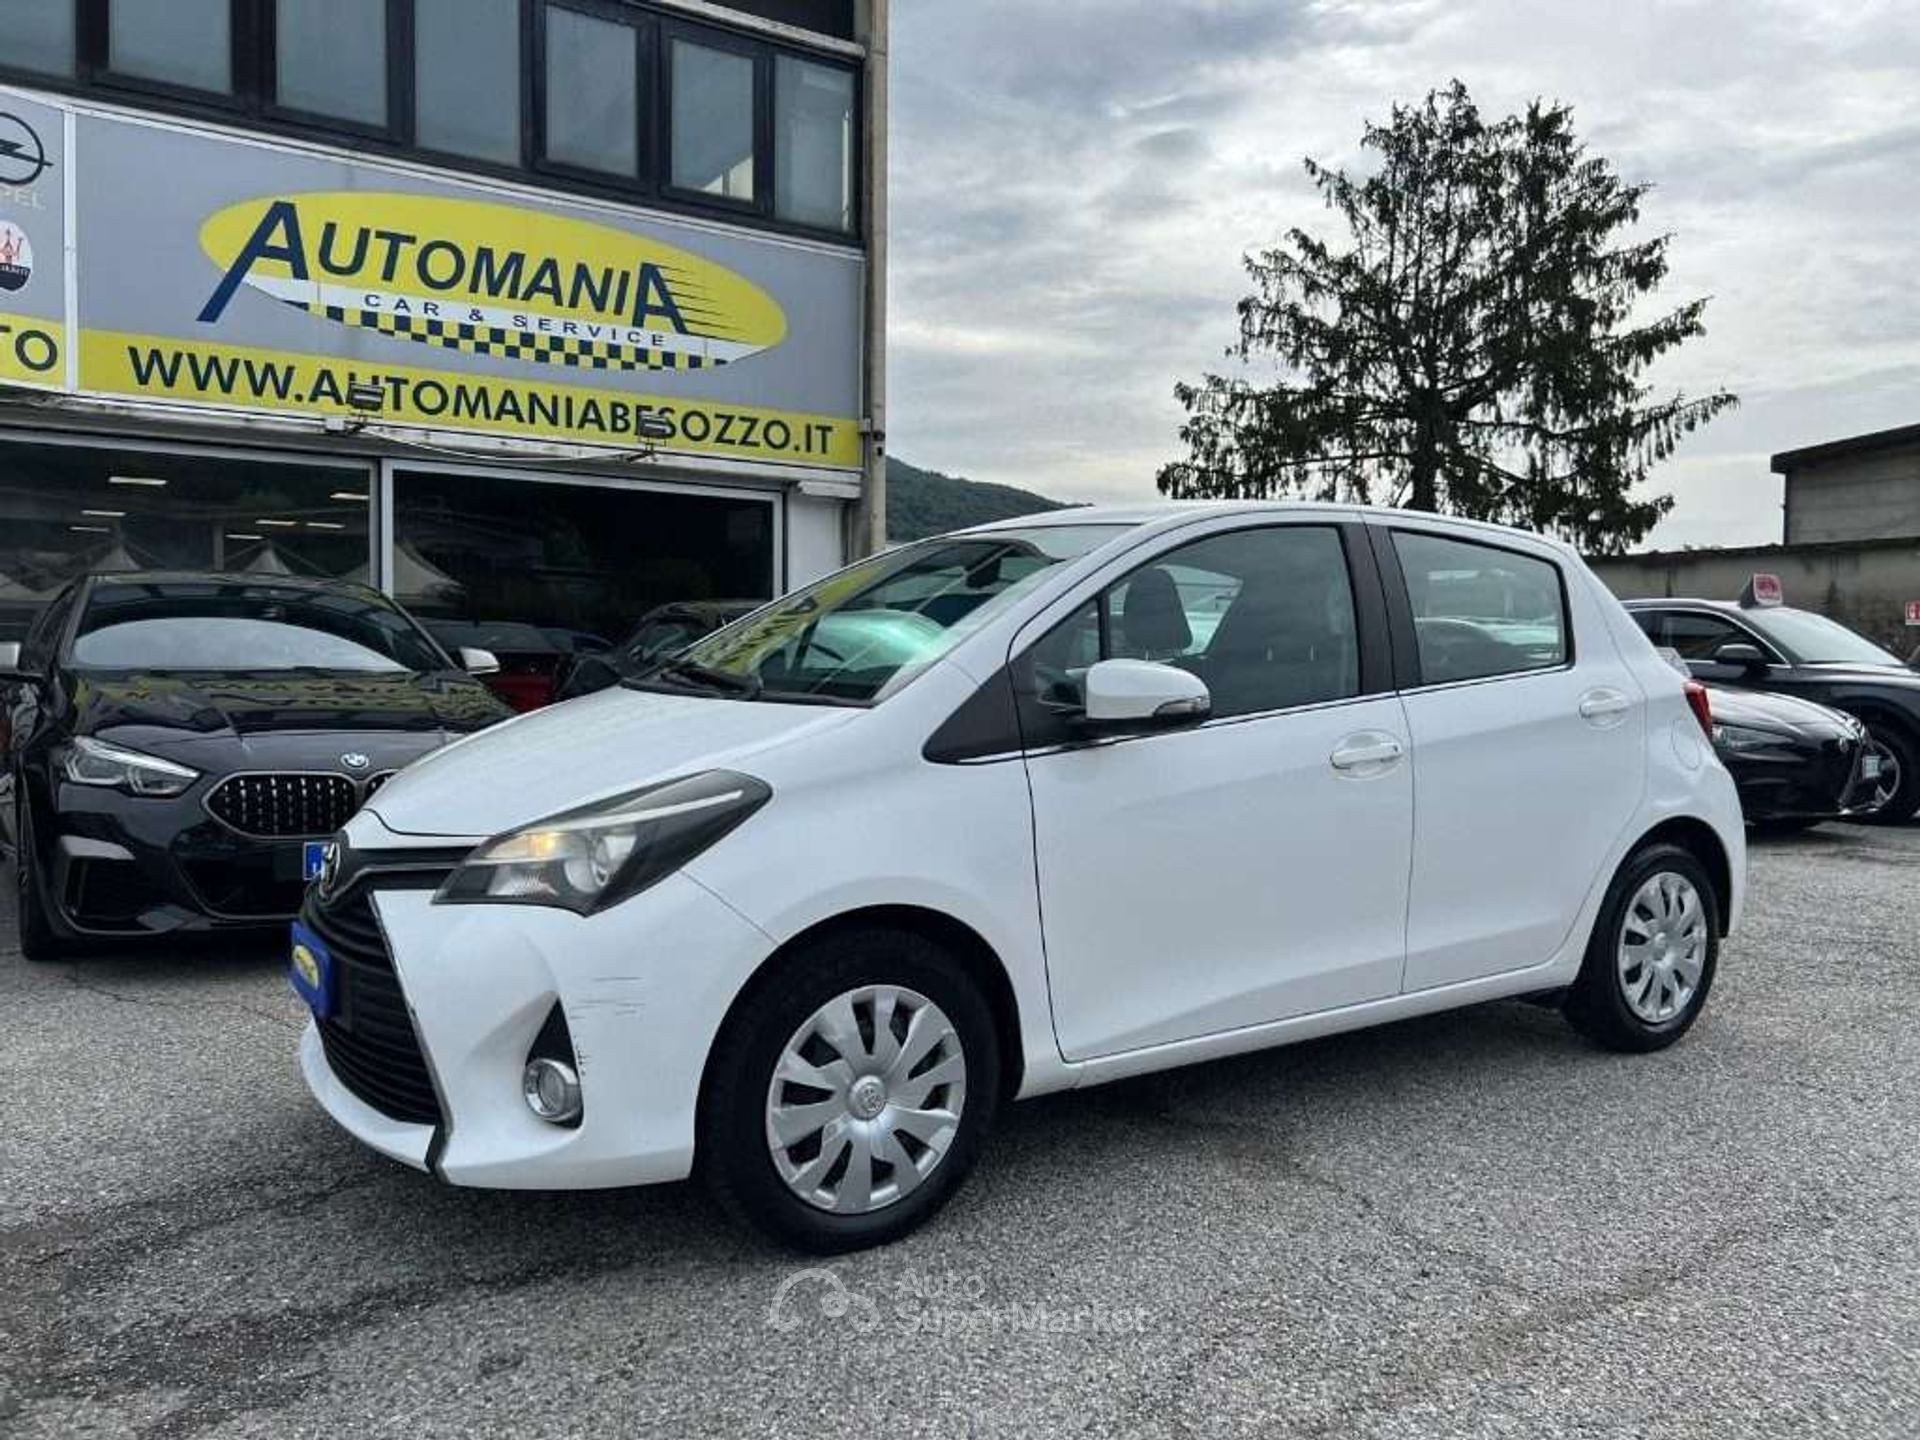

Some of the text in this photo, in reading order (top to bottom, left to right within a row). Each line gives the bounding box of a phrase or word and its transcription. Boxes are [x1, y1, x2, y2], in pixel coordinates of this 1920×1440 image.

[196, 201, 690, 335] AUTOMANIA
[364, 294, 665, 347] CAR & SERVICE
